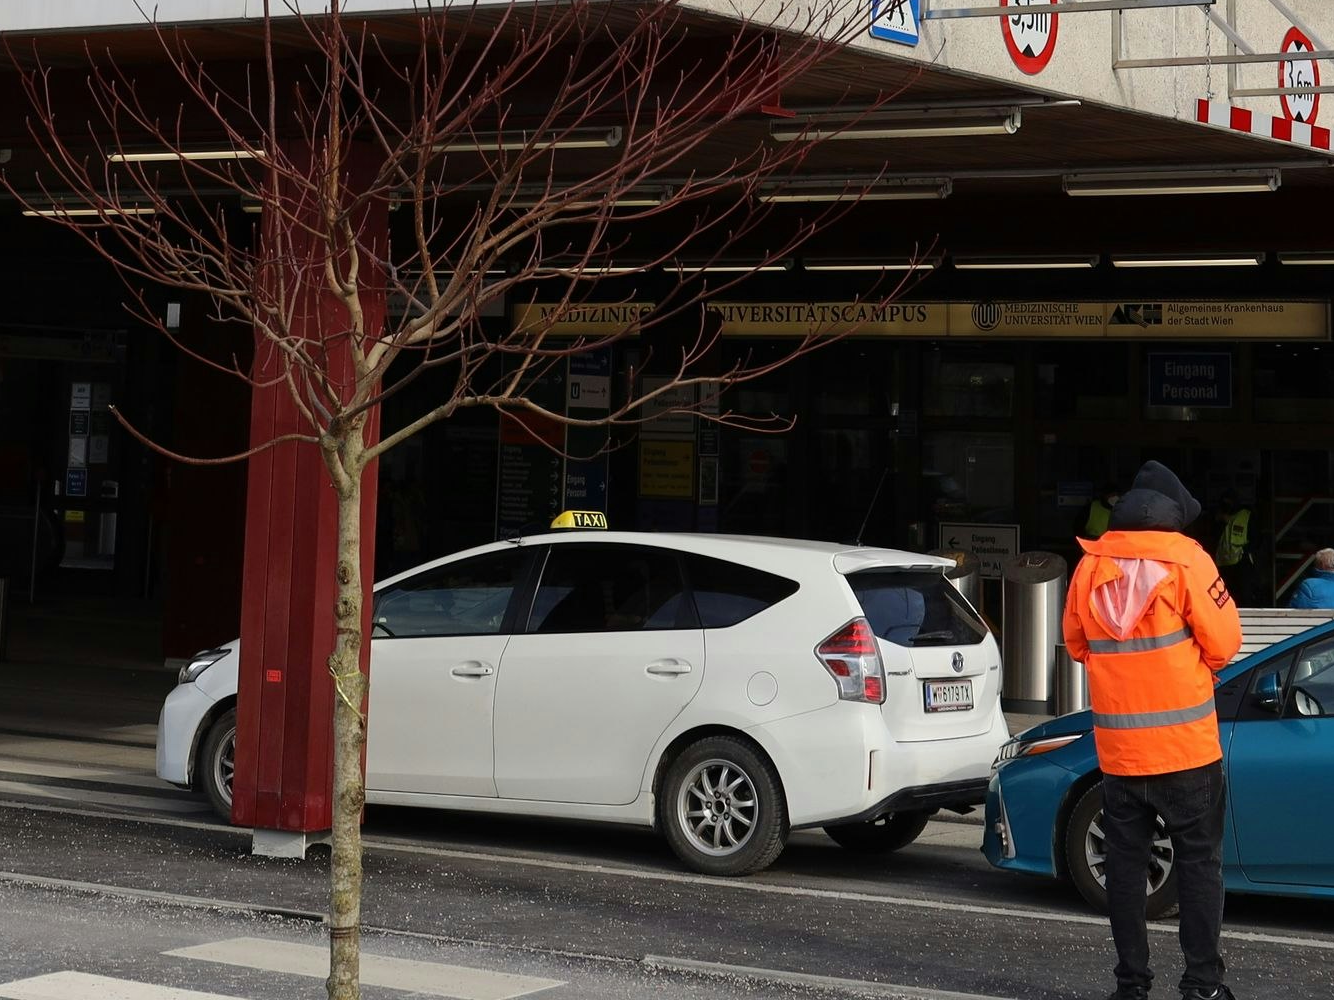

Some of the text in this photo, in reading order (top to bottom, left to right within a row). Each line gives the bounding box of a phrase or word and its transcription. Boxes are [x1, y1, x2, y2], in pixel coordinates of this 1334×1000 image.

[708, 303, 927, 323] NIVERSITÄTSCAMPUS
[1004, 304, 1079, 314] MEDIZINISCHE
[1167, 303, 1284, 315] Allgemeines Krankenhaus
[1004, 314, 1103, 326] UNIVERSITÄT WIEN
[1167, 316, 1234, 327] der Stadt Wien
[1165, 361, 1214, 380] Eingang
[1163, 383, 1218, 399] Personal
[574, 514, 605, 527] TAXI
